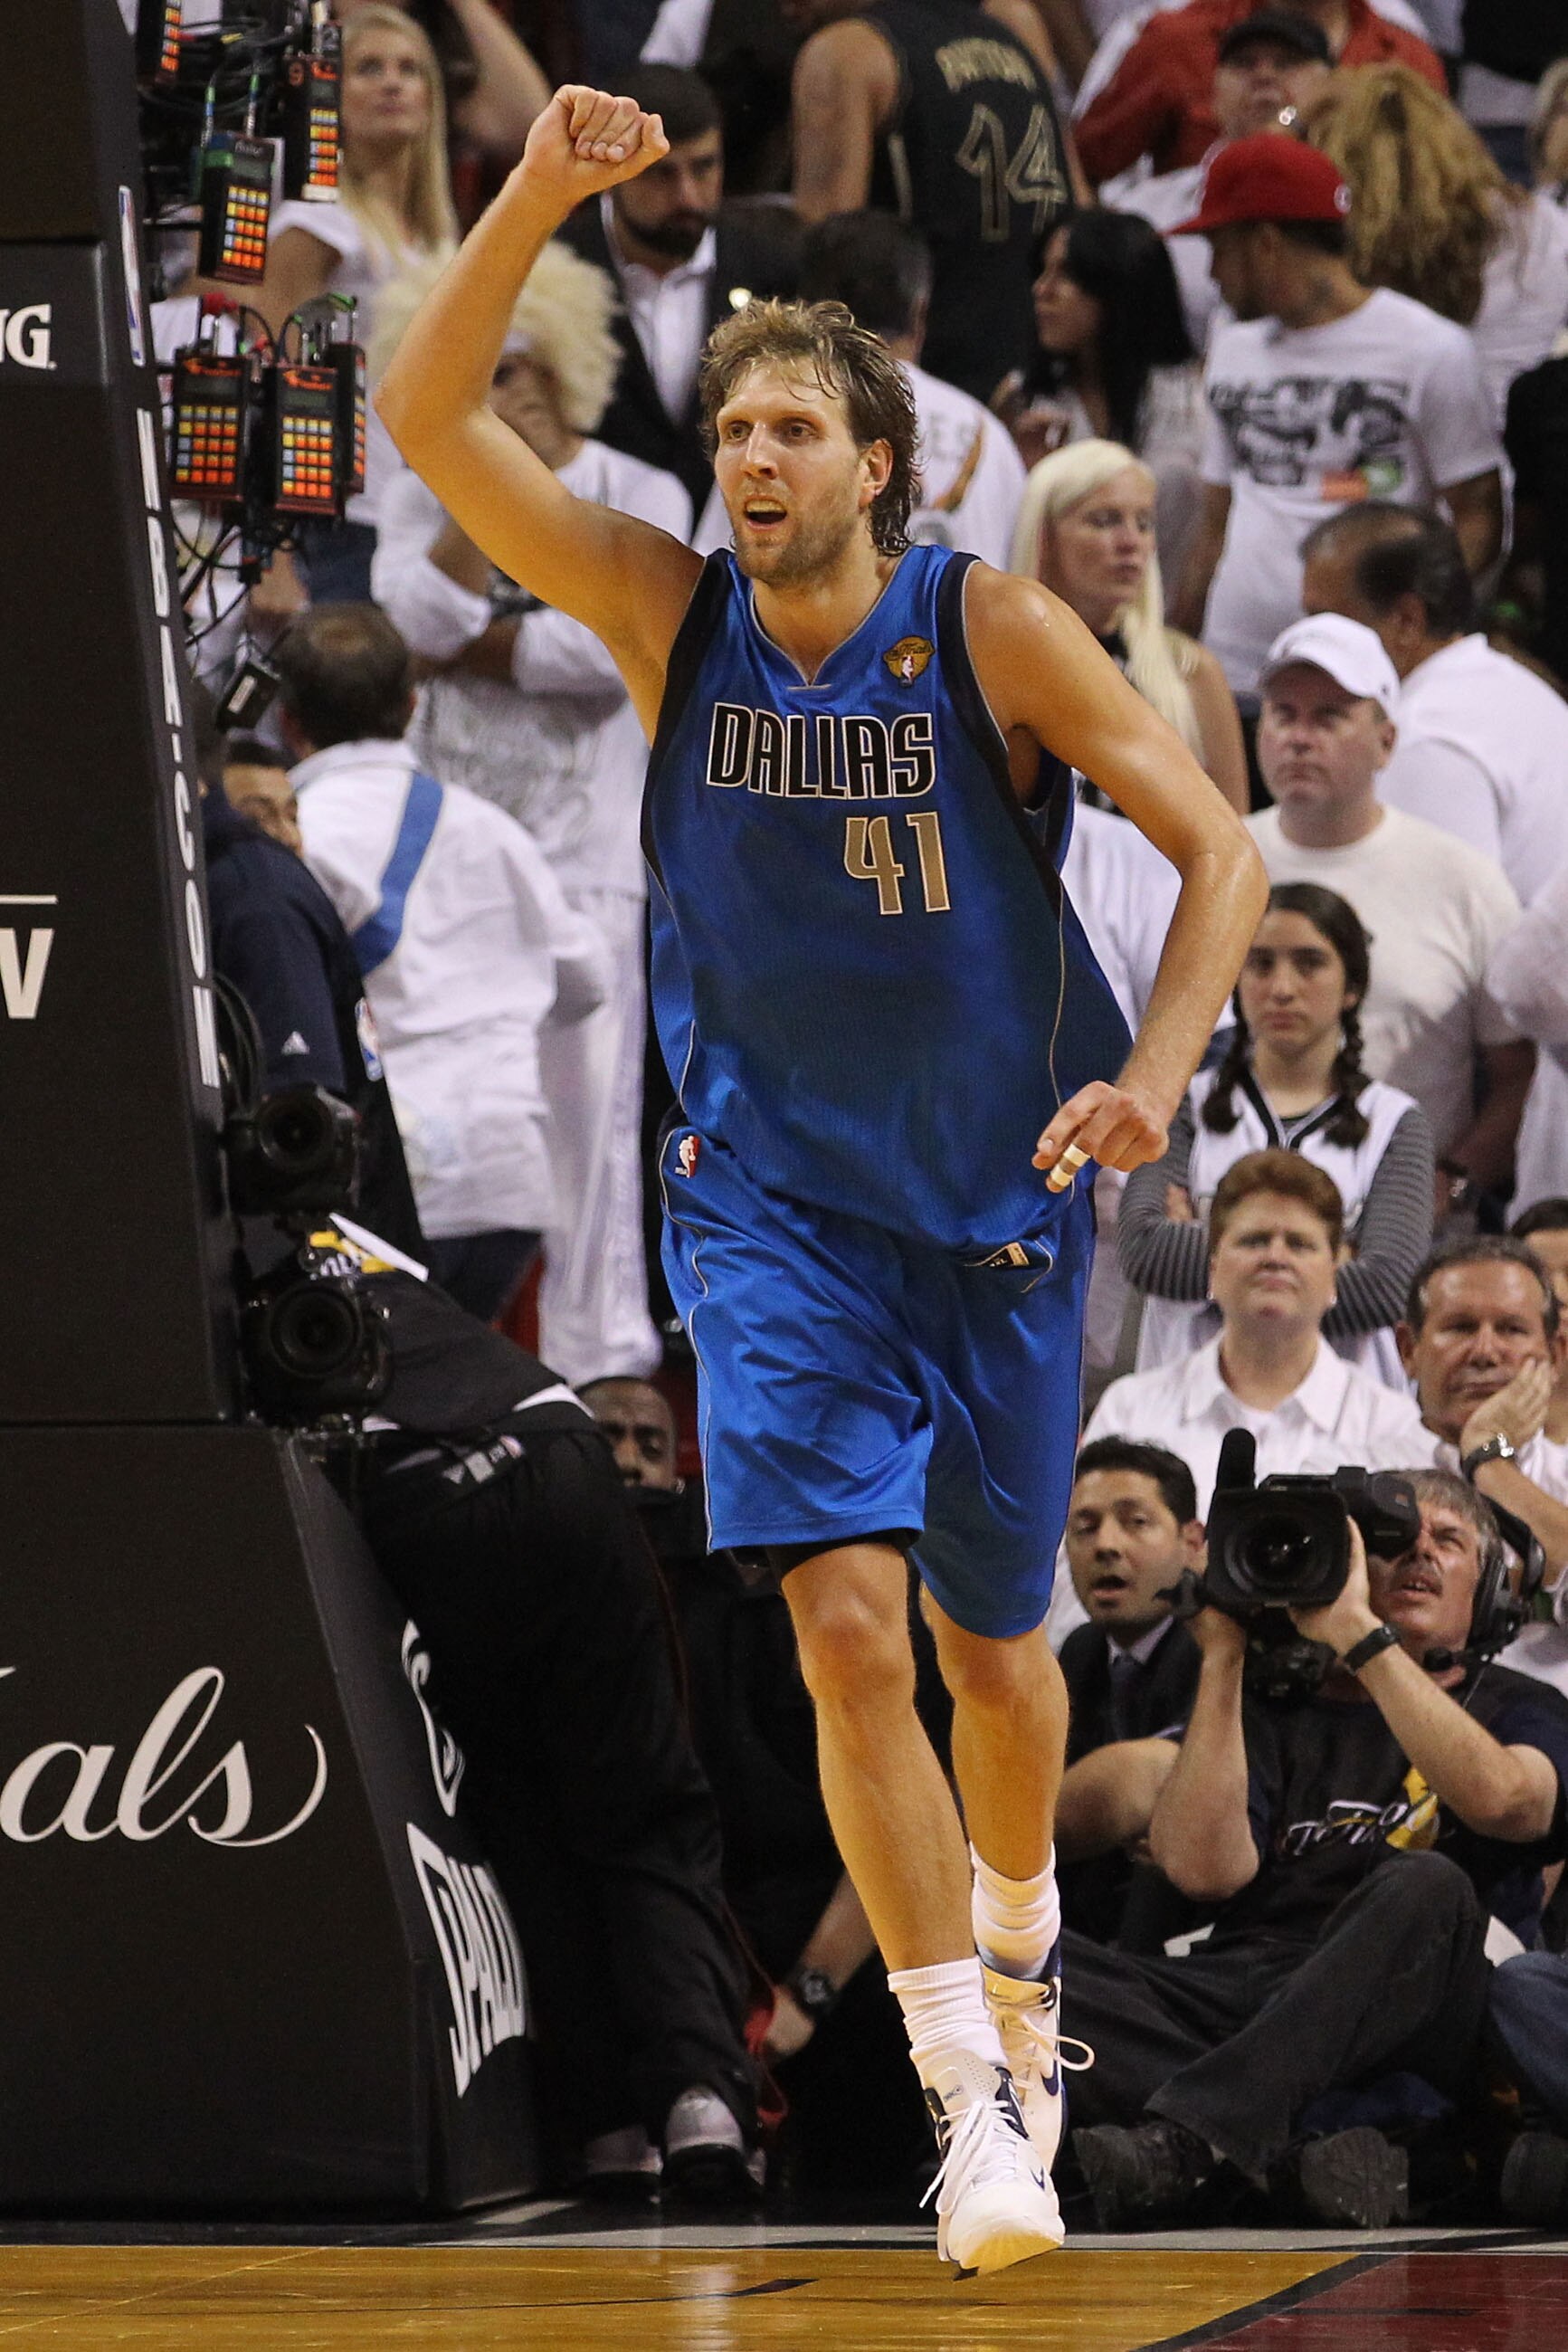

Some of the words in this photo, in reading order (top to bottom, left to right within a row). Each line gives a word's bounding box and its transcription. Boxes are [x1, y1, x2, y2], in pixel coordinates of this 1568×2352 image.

[0, 303, 52, 369] G
[137, 407, 219, 1088] NBA.COM
[707, 702, 936, 800] DALLAS
[844, 811, 950, 914] 41
